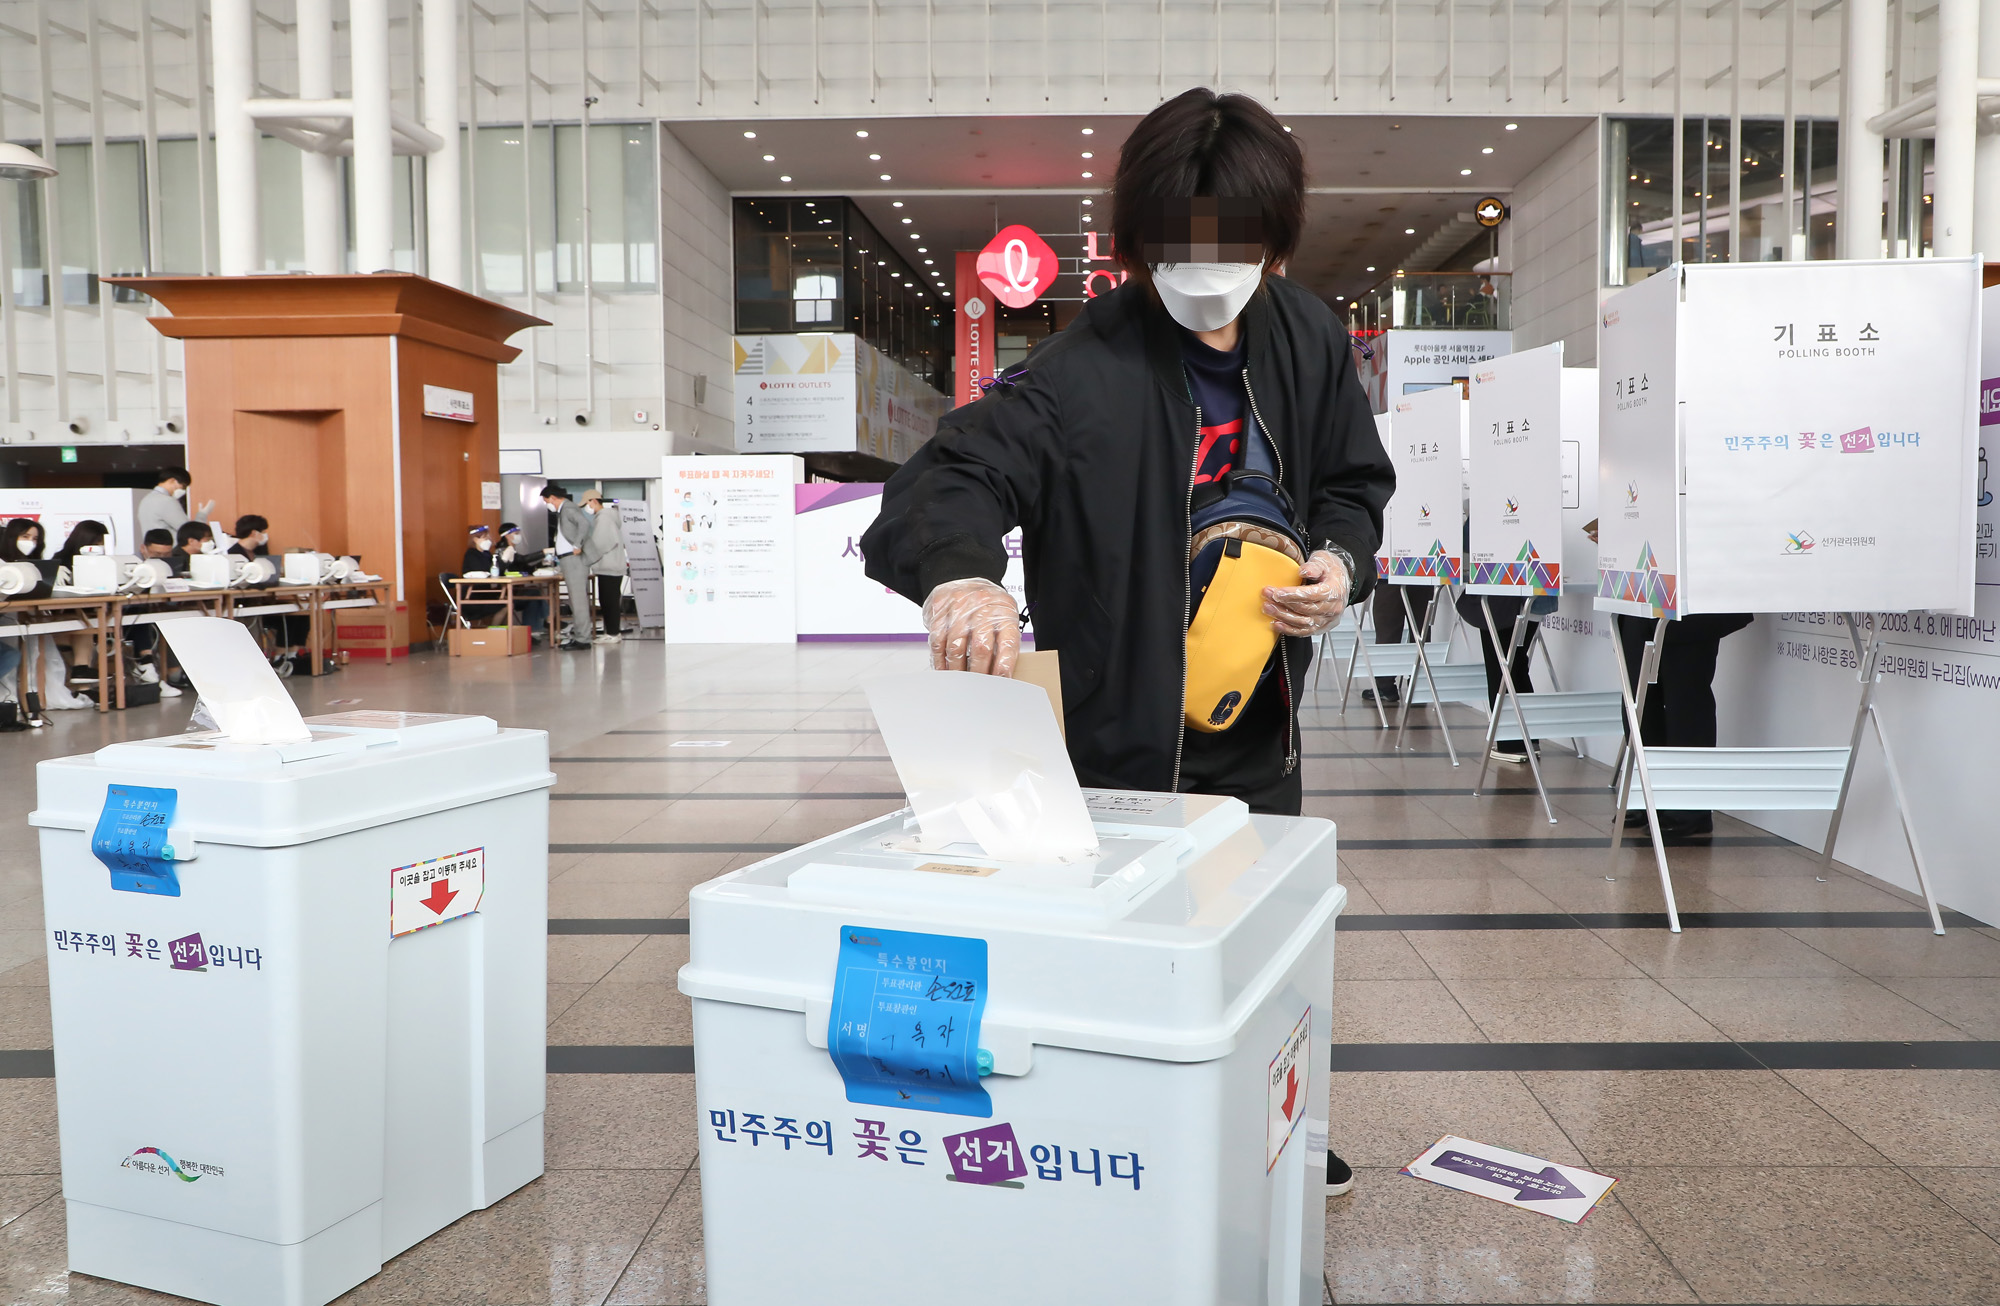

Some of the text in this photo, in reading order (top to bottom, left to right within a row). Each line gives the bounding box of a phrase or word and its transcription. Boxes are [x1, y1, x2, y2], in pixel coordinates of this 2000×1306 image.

[1404, 355, 1430, 365] Apple
[1433, 355, 1450, 364] 공인
[1451, 355, 1477, 364] 서비스
[1778, 347, 1876, 358] POLLING BOOTH
[970, 323, 980, 403] LOTTE OUTL
[746, 396, 753, 406] 4
[747, 414, 753, 425] 3
[747, 433, 754, 443] 2
[1724, 435, 1789, 451] 민주주의
[1798, 431, 1834, 450] 꽃은
[1822, 536, 1876, 548] 선거관리위원회
[1956, 618, 1996, 642] 태어난
[1786, 642, 1810, 661] 자세한
[1812, 645, 1838, 666] 사항은
[400, 858, 477, 886] 이곳을 잡고 이동해 주세요
[54, 930, 116, 956] 민주주의
[124, 932, 161, 960] 꽃은
[877, 952, 946, 974] 특수봉인지
[882, 978, 922, 991] 투표관리관
[878, 1001, 917, 1015] 투표참관인
[709, 1108, 834, 1156] 민주주의
[852, 1118, 928, 1165] 꽃은
[132, 1160, 224, 1176] 아름다운 선거 행복한 대한민국
